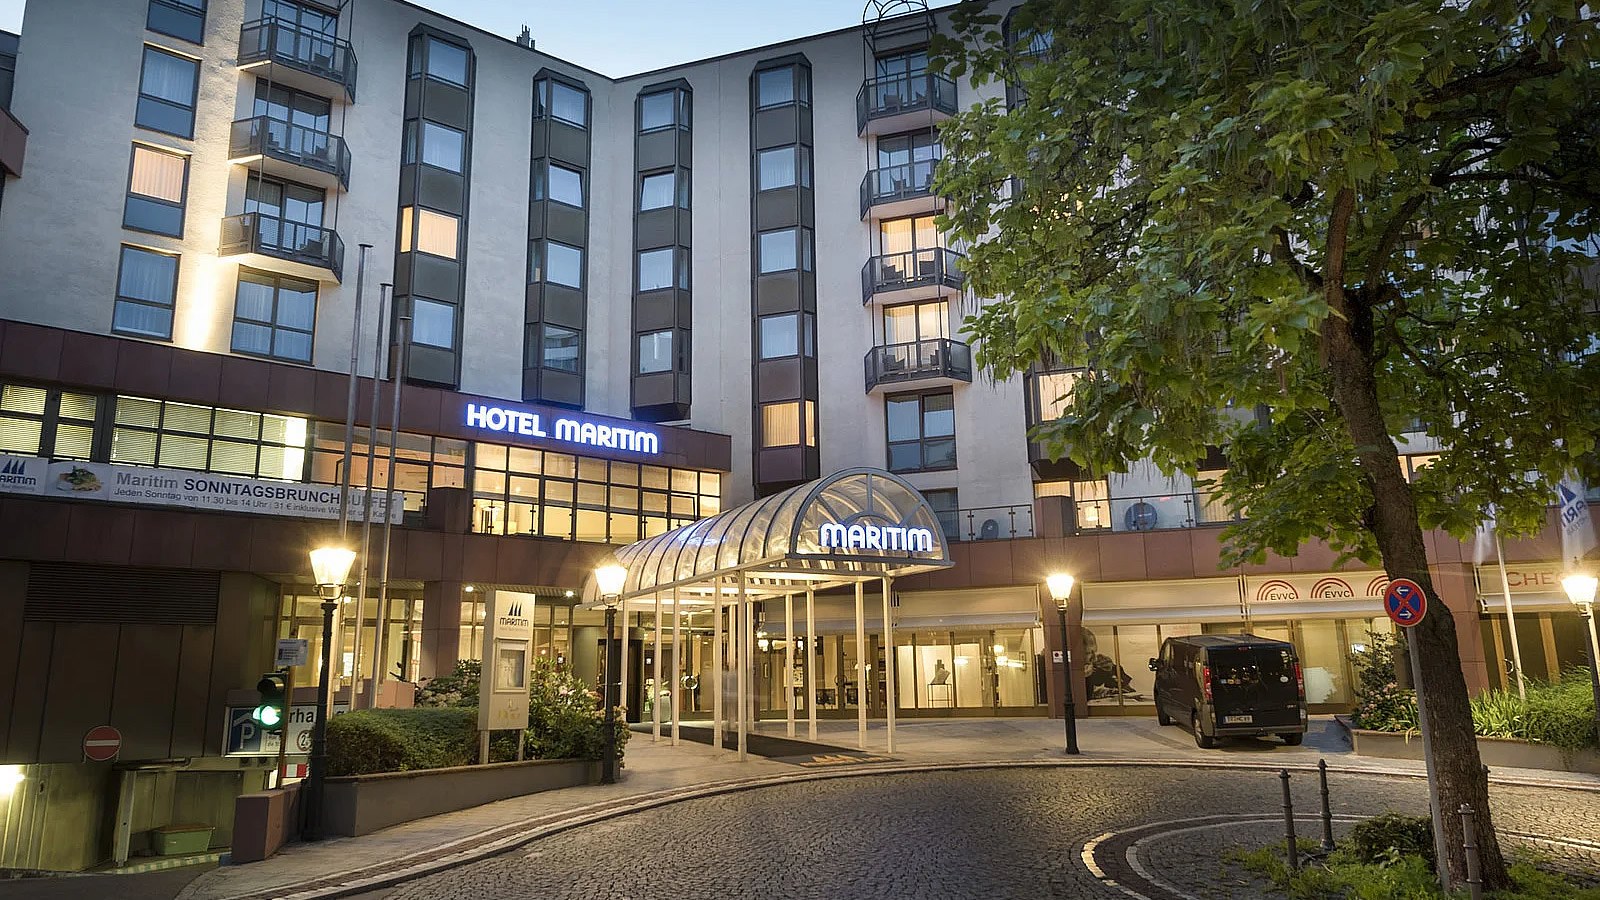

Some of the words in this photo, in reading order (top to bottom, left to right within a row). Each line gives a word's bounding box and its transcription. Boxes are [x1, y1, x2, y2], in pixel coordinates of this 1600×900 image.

[467, 403, 546, 438] HOTEL
[555, 418, 658, 454] MARITIM
[0, 474, 37, 486] ARITIM
[116, 472, 178, 489] Maritim
[114, 487, 142, 497] Jeden
[145, 489, 181, 500] Sonntag
[184, 494, 199, 502] von
[226, 497, 238, 506] bis
[241, 498, 251, 506] 14
[253, 500, 268, 508] Uhr
[820, 522, 933, 552] MARITIM
[1506, 571, 1556, 587] CHE
[1270, 593, 1295, 601] EVVC
[1325, 590, 1351, 599] EVVC
[499, 617, 529, 628] MARITIM
[240, 722, 255, 749] P
